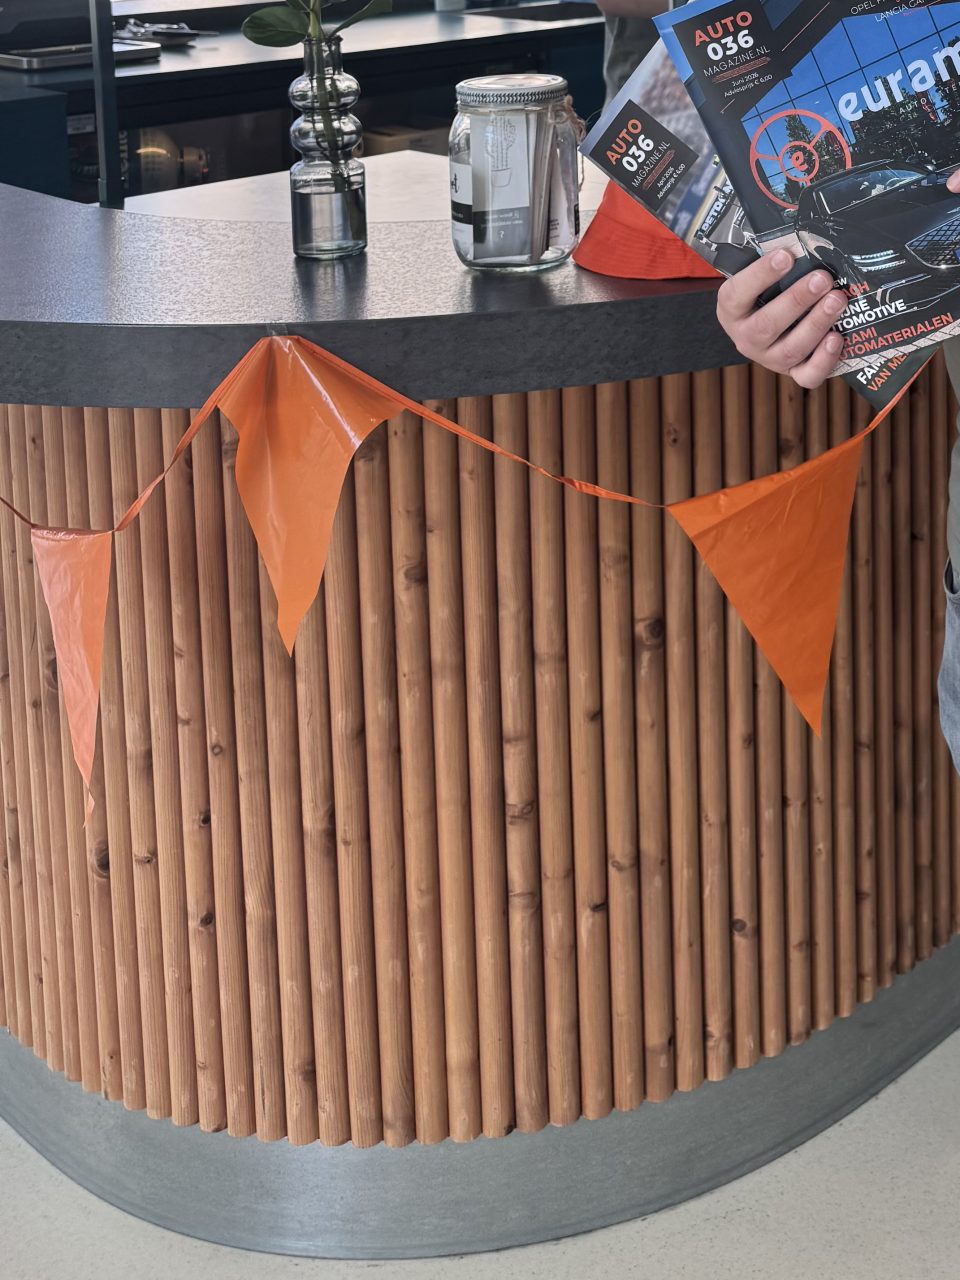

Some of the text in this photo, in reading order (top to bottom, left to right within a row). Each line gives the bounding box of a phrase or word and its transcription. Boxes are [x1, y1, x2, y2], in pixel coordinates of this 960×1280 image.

[850, 0, 876, 15] OPEL
[874, 2, 909, 22] LANCIA
[694, 10, 753, 48] AUTO
[706, 29, 754, 61] 036
[703, 45, 771, 77] MAGAZINE.NL
[605, 118, 642, 166] AUTO
[621, 134, 655, 172] 036
[631, 140, 672, 188] MAGAZINE.NL
[832, 299, 907, 332] TOMOTIVE
[839, 312, 954, 360] UTOMATERIALEN
[867, 352, 909, 391] VAN ME
